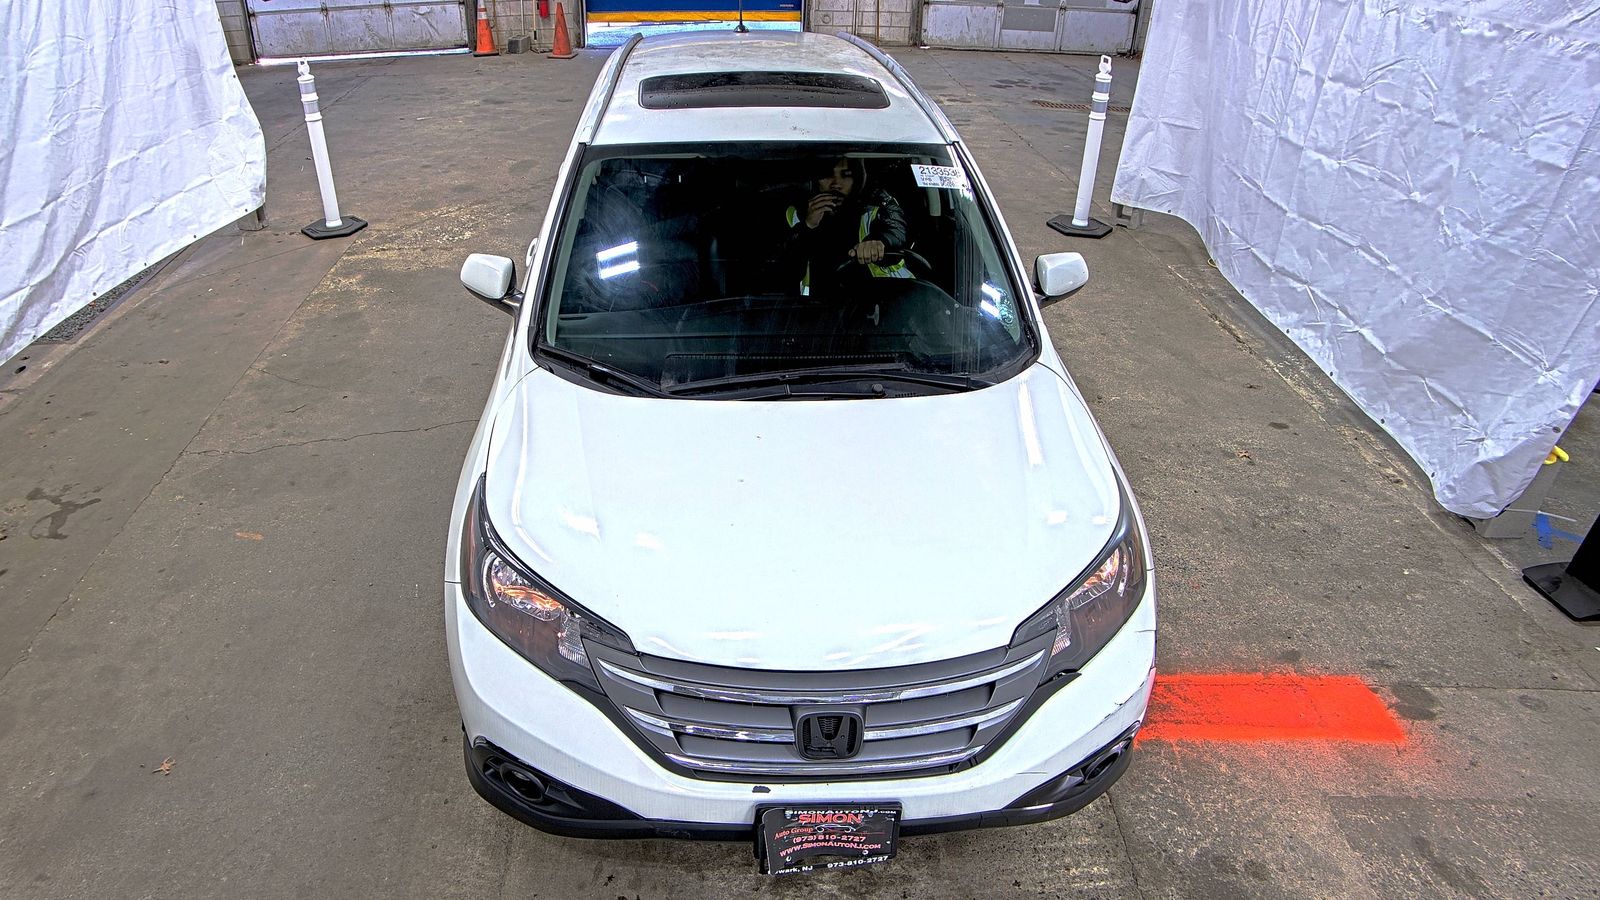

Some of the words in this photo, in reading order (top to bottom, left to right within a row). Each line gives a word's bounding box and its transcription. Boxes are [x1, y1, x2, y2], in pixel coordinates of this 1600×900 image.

[798, 813, 863, 824] SIMON
[774, 829, 790, 840] Auto
[790, 826, 814, 835] Group
[827, 855, 889, 869] 973-810-2727
